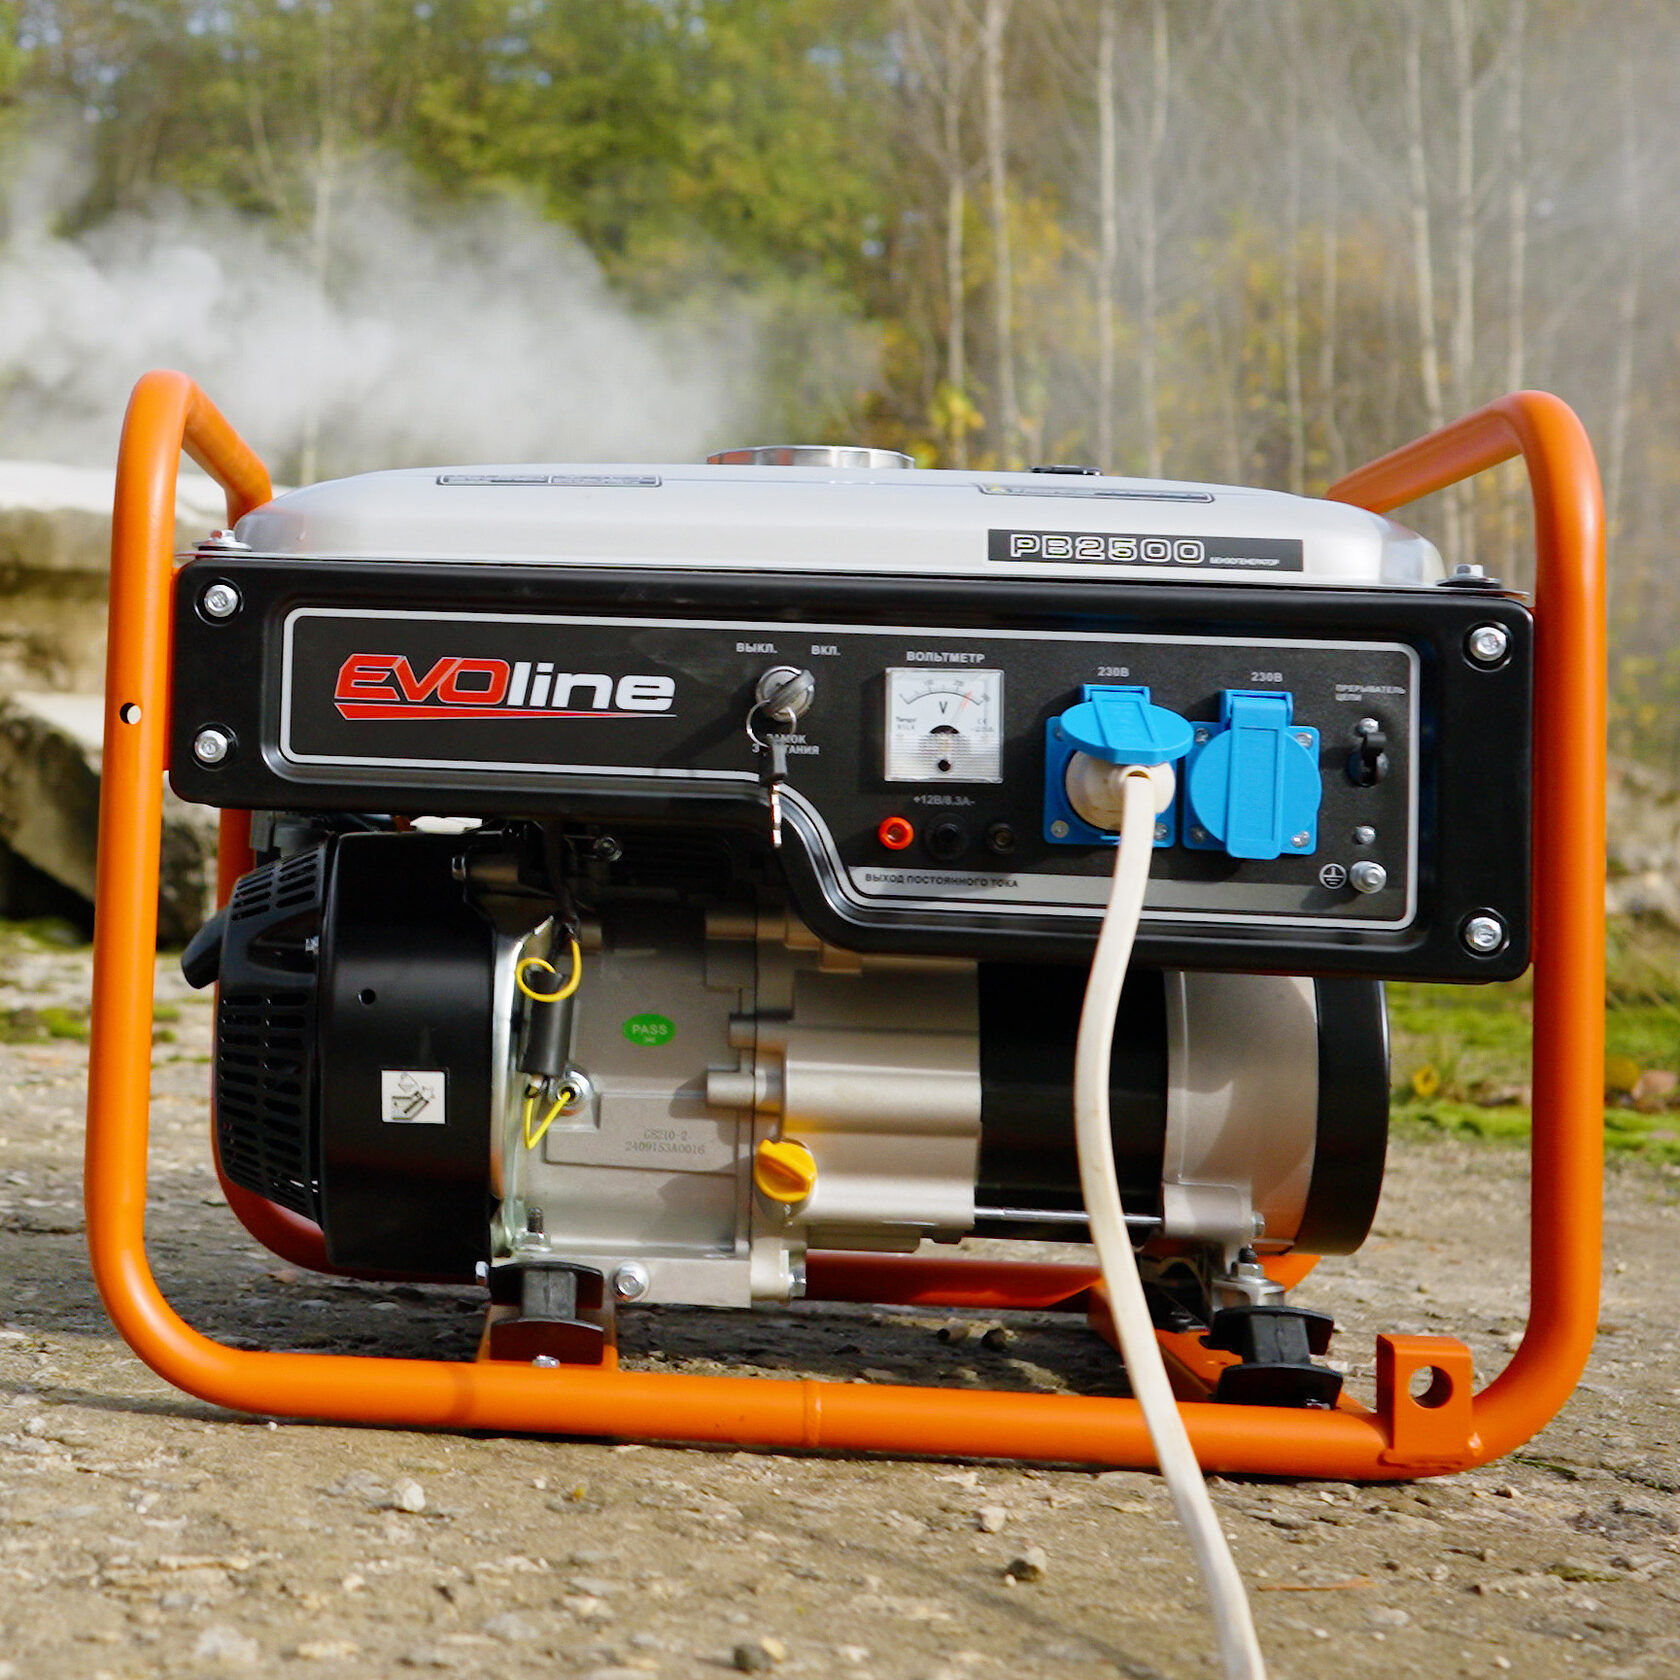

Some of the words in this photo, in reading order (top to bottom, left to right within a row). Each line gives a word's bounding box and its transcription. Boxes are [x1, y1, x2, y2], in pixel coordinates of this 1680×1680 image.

[1010, 533, 1205, 564] PB2500
[736, 642, 778, 654] ВЫКЛ.
[811, 645, 841, 656] ВКЛ.
[906, 651, 986, 664] ВОЛЬТМЕТР
[334, 653, 676, 711] EVOline
[865, 873, 905, 884] ВЫХОД
[907, 875, 989, 888] ПОСТОЯННОГО
[991, 879, 1019, 888] ТОКА
[632, 1024, 668, 1035] PASS
